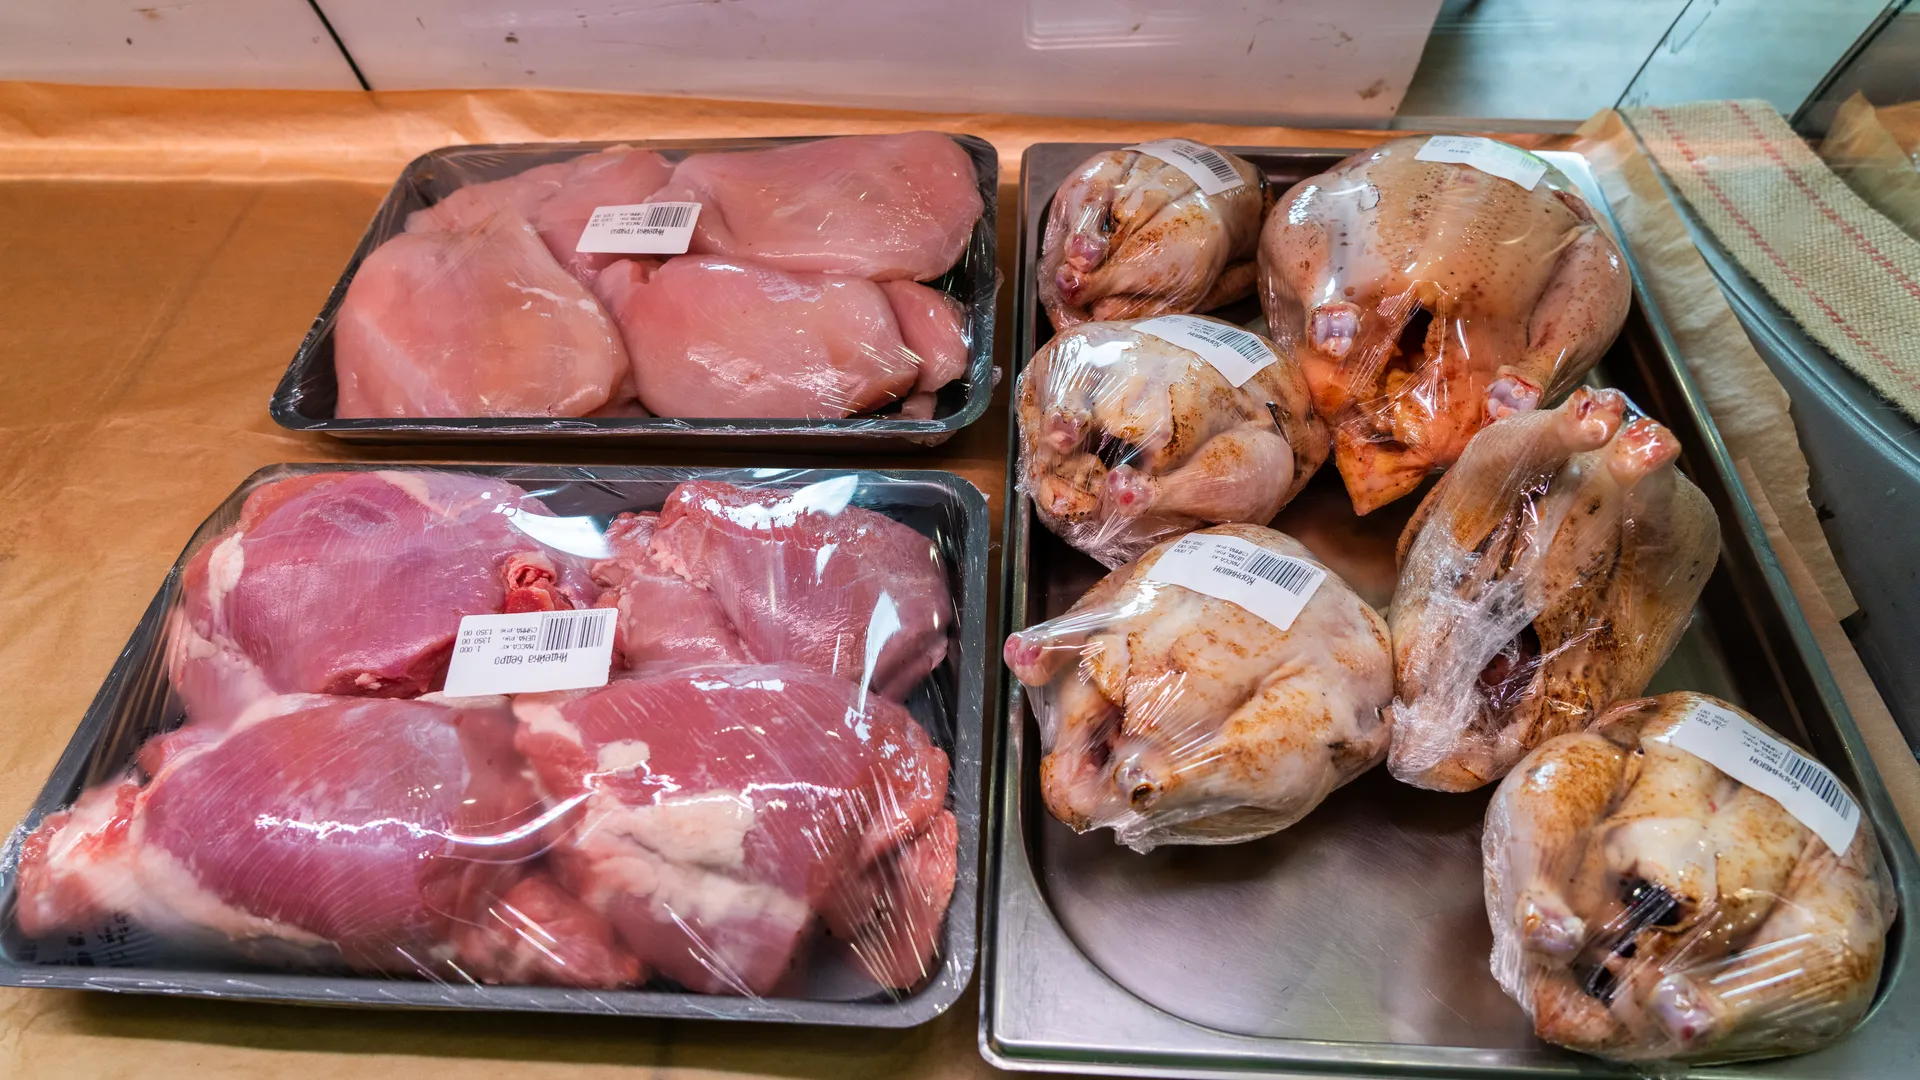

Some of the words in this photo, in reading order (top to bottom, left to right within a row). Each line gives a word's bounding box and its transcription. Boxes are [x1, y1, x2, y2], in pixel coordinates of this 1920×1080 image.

[1212, 565, 1257, 586] Корнишон
[459, 646, 481, 654] 1.000
[494, 654, 524, 666] бедро
[528, 652, 568, 665] Индейка
[1749, 756, 1801, 791] Корнишон
